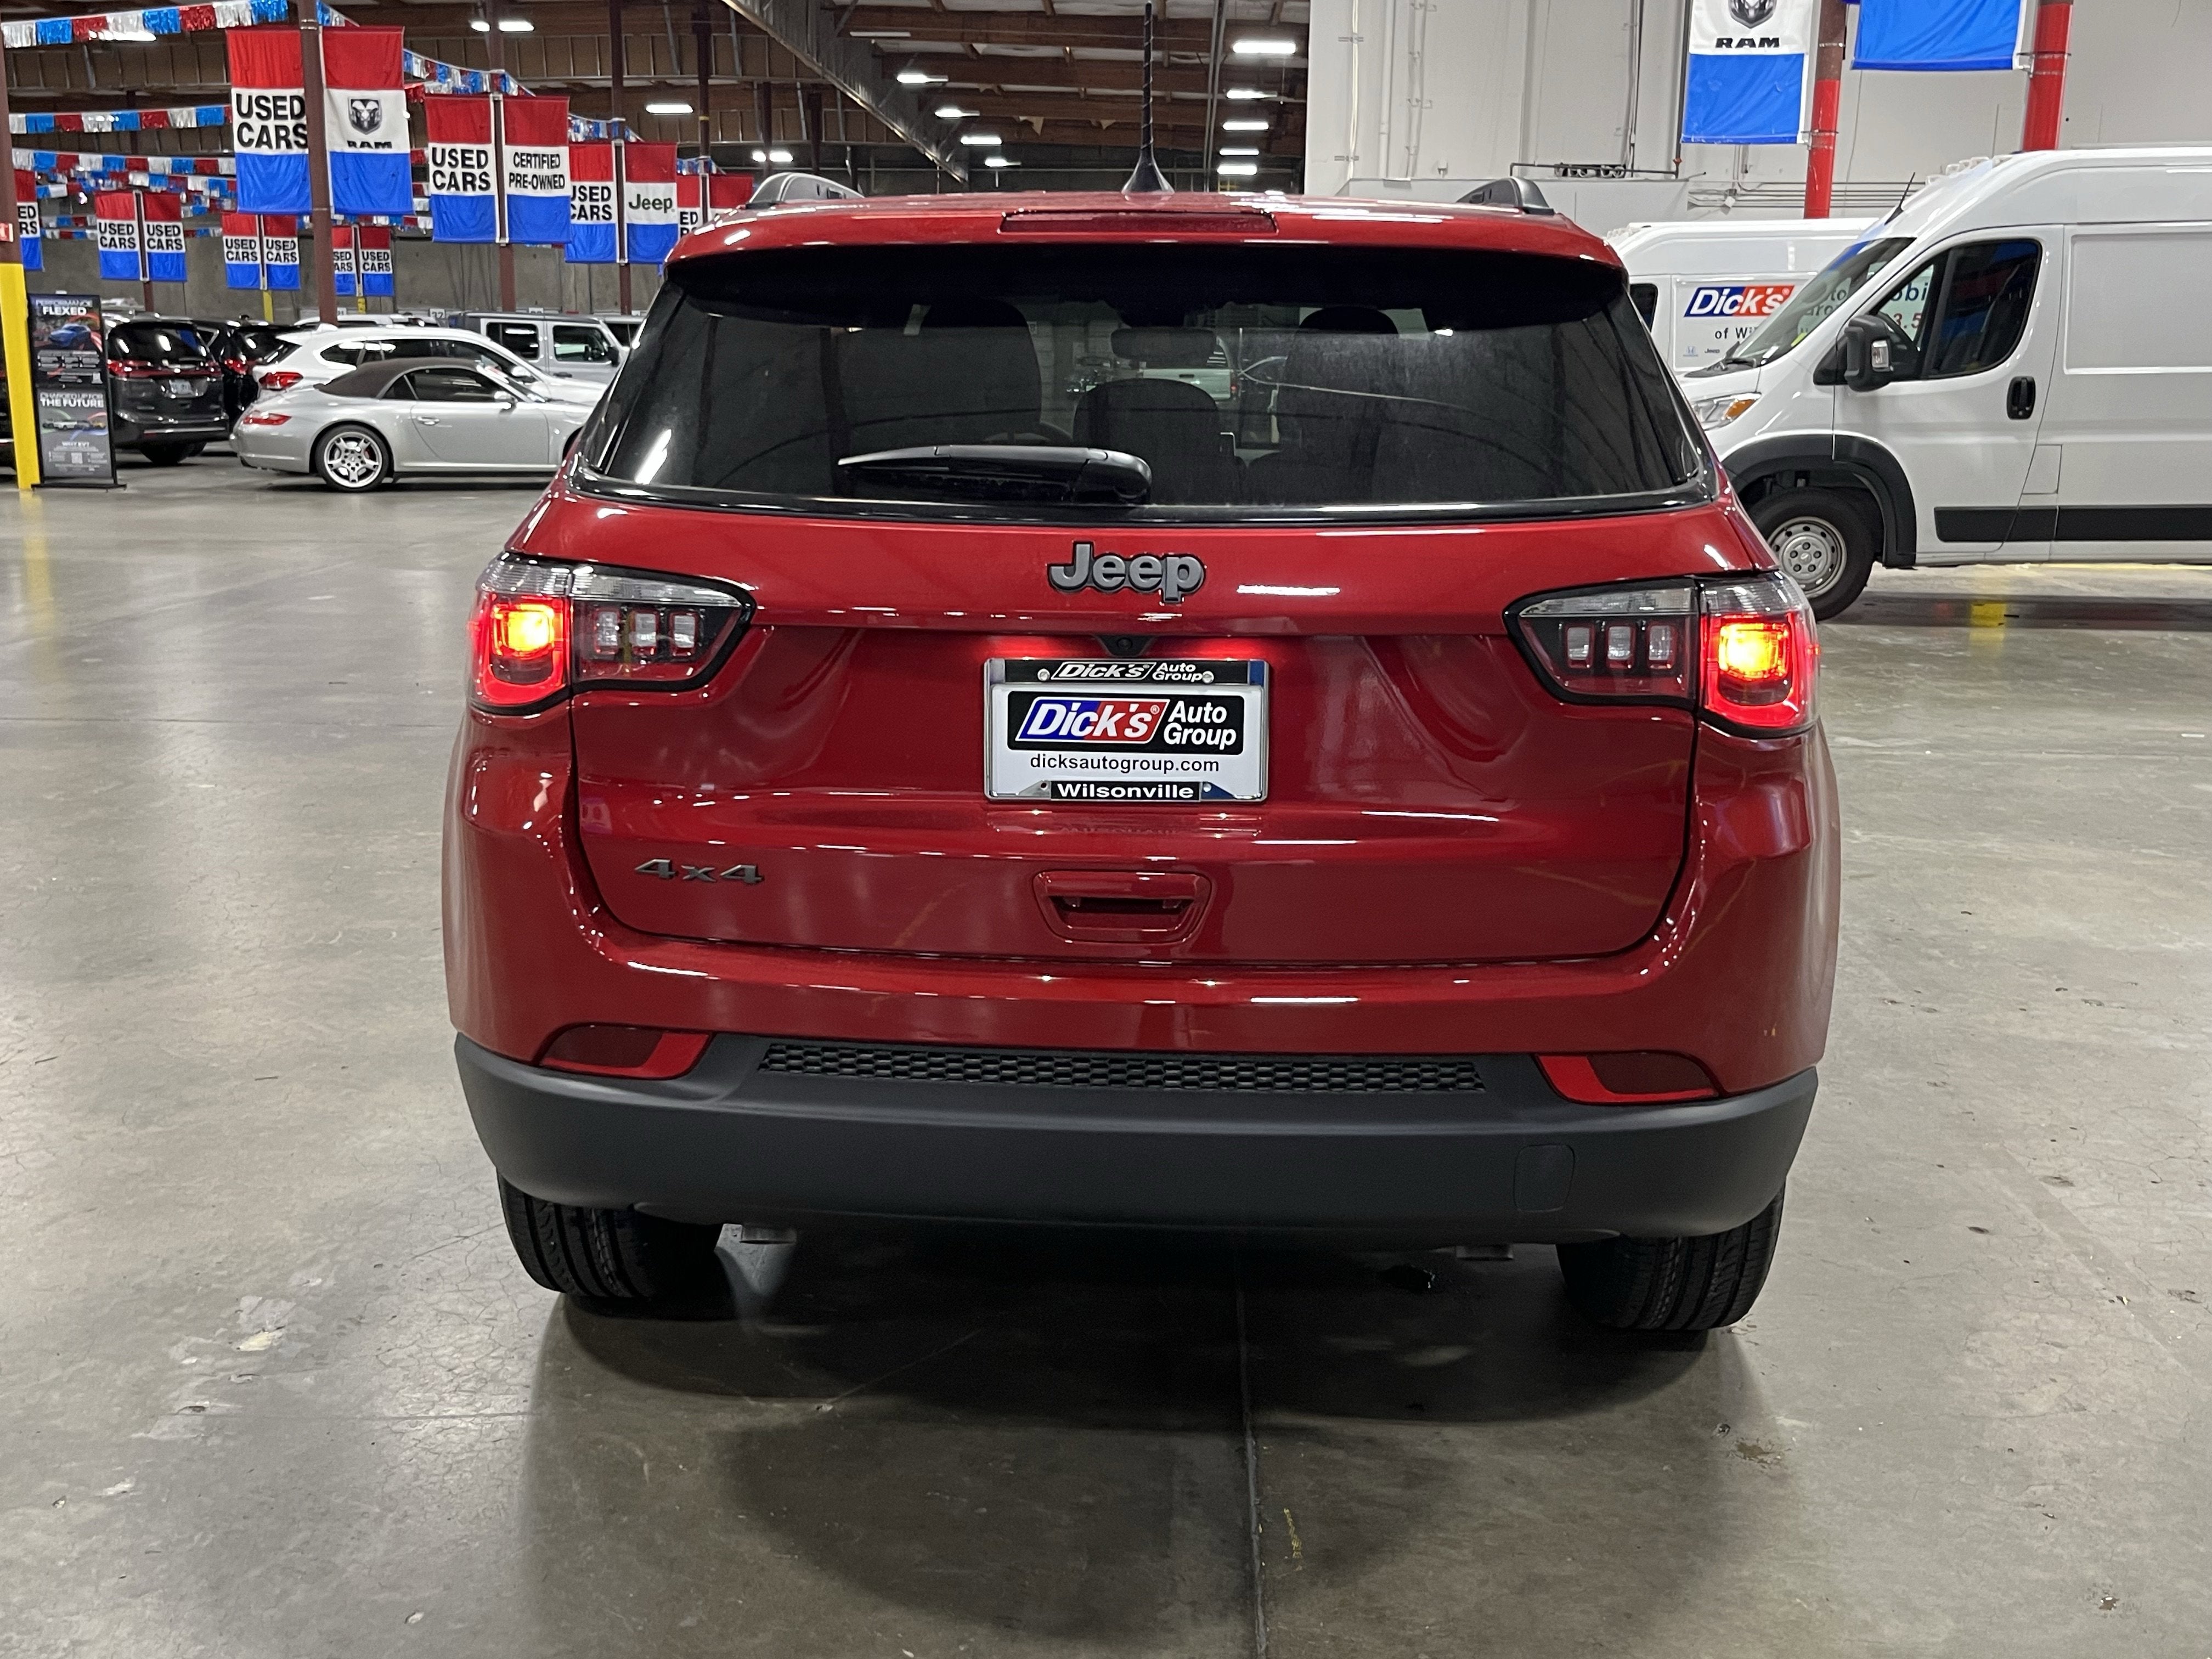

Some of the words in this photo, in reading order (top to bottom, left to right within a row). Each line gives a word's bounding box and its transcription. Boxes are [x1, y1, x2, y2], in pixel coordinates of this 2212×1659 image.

[1715, 37, 1780, 49] RAM
[236, 93, 306, 121] USED
[237, 122, 307, 150] CARS
[431, 147, 489, 170] USED
[513, 152, 561, 169] CERTIFIED
[432, 170, 491, 191] CARS
[509, 172, 566, 190] PRE-OWNED
[628, 194, 673, 213] Jeep
[18, 205, 36, 219] ED
[680, 211, 698, 225] ED
[19, 221, 38, 235] RS
[99, 223, 134, 235] USED
[146, 224, 181, 237] USED
[100, 236, 136, 249] CARS
[147, 238, 183, 250] CARS
[225, 239, 257, 250] USED
[266, 239, 296, 251] USED
[226, 251, 258, 262] CARS
[267, 251, 297, 263] CARS
[333, 251, 352, 261] SED
[362, 251, 390, 261] USED
[363, 262, 391, 272] CARS
[1689, 287, 1784, 314] Dick's
[42, 306, 87, 316] FLEXED
[1714, 327, 1729, 339] of
[40, 398, 61, 407] THE
[63, 399, 104, 408] FUTURE
[1048, 542, 1205, 603] Jeep
[1058, 664, 1145, 678] Dick's
[1156, 662, 1196, 673] Auto
[1152, 671, 1204, 682] Group
[1026, 702, 1153, 738] Dick's
[1167, 700, 1227, 724] Auto
[1163, 722, 1237, 751] Group
[1030, 753, 1220, 774] dicksautogroup.com
[1057, 783, 1194, 798] Wilsonville
[634, 858, 764, 884] 4x4
